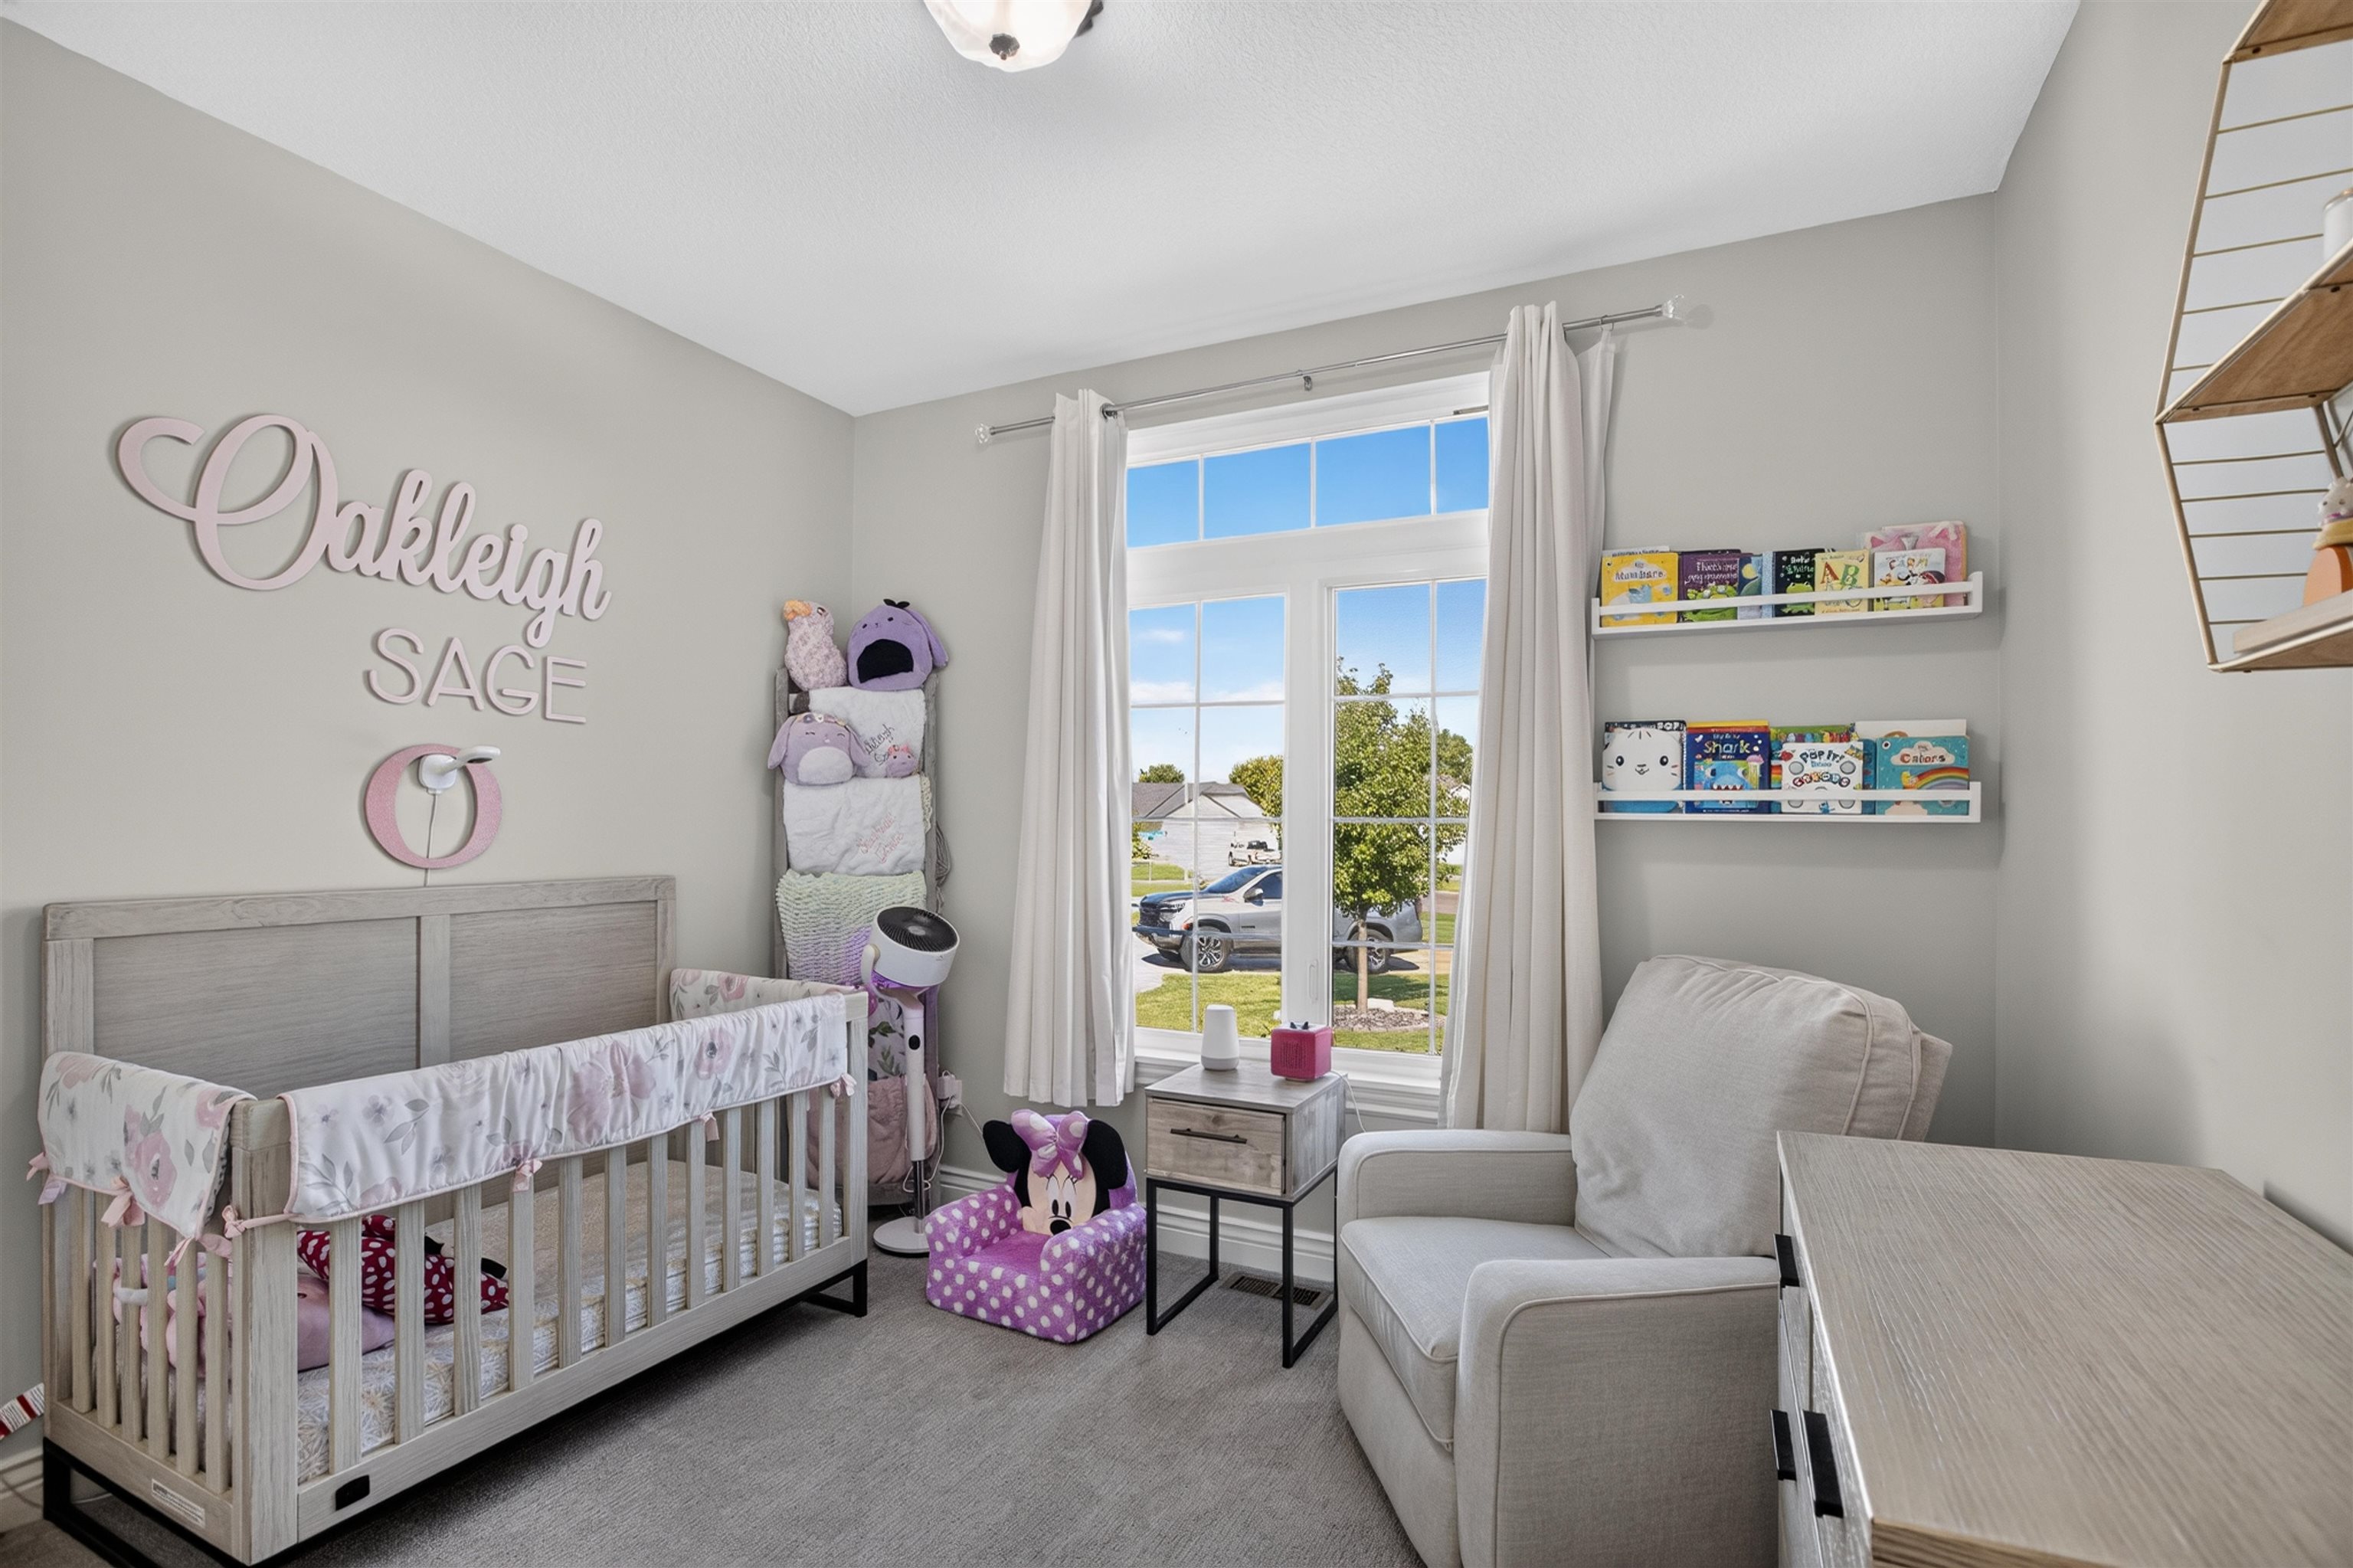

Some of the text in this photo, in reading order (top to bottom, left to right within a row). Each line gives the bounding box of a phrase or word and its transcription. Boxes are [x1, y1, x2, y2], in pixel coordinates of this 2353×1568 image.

[116, 414, 612, 648] Oakleigh
[368, 628, 587, 725] SAGE
[1703, 739, 1751, 754] Shark
[1799, 750, 1825, 764] POP
[365, 743, 502, 869] O
